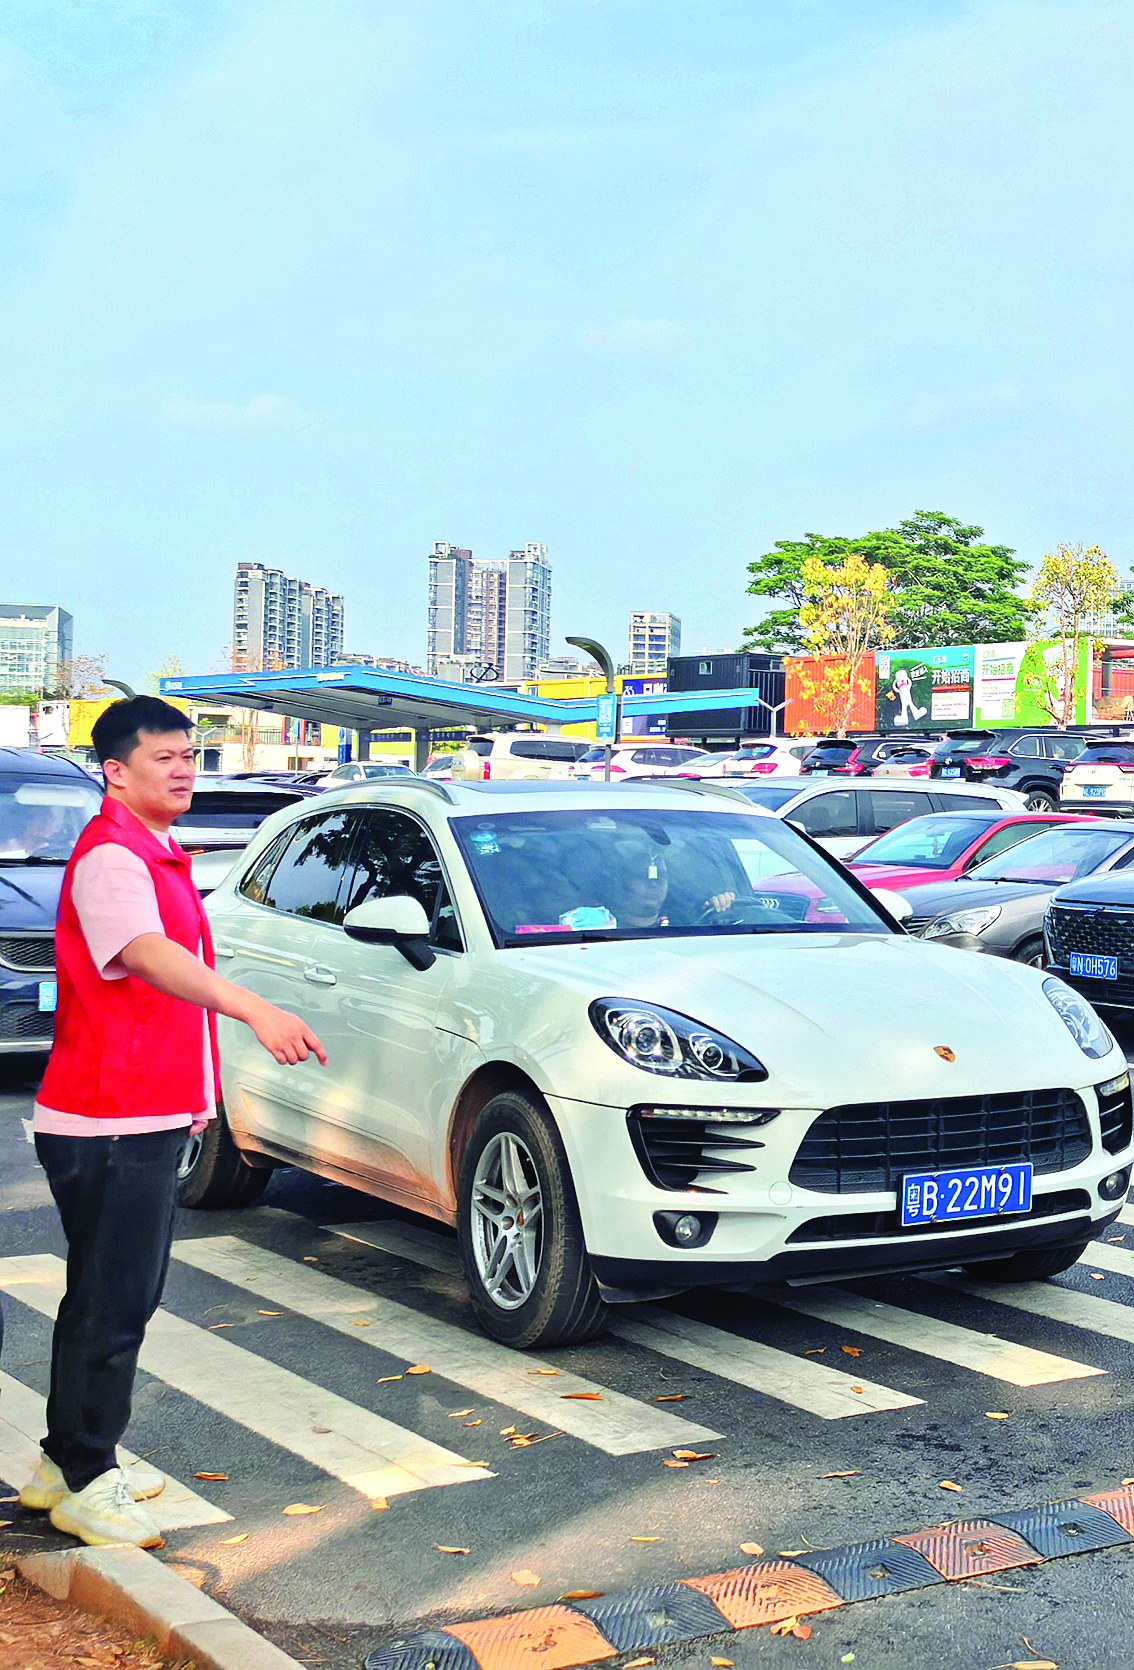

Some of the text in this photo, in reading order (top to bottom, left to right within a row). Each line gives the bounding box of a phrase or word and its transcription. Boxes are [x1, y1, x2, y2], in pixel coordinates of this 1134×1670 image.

[931, 669, 970, 685] 开始招商
[981, 662, 1014, 676] 开始招商
[906, 1171, 1025, 1217] 粤B·22M91
